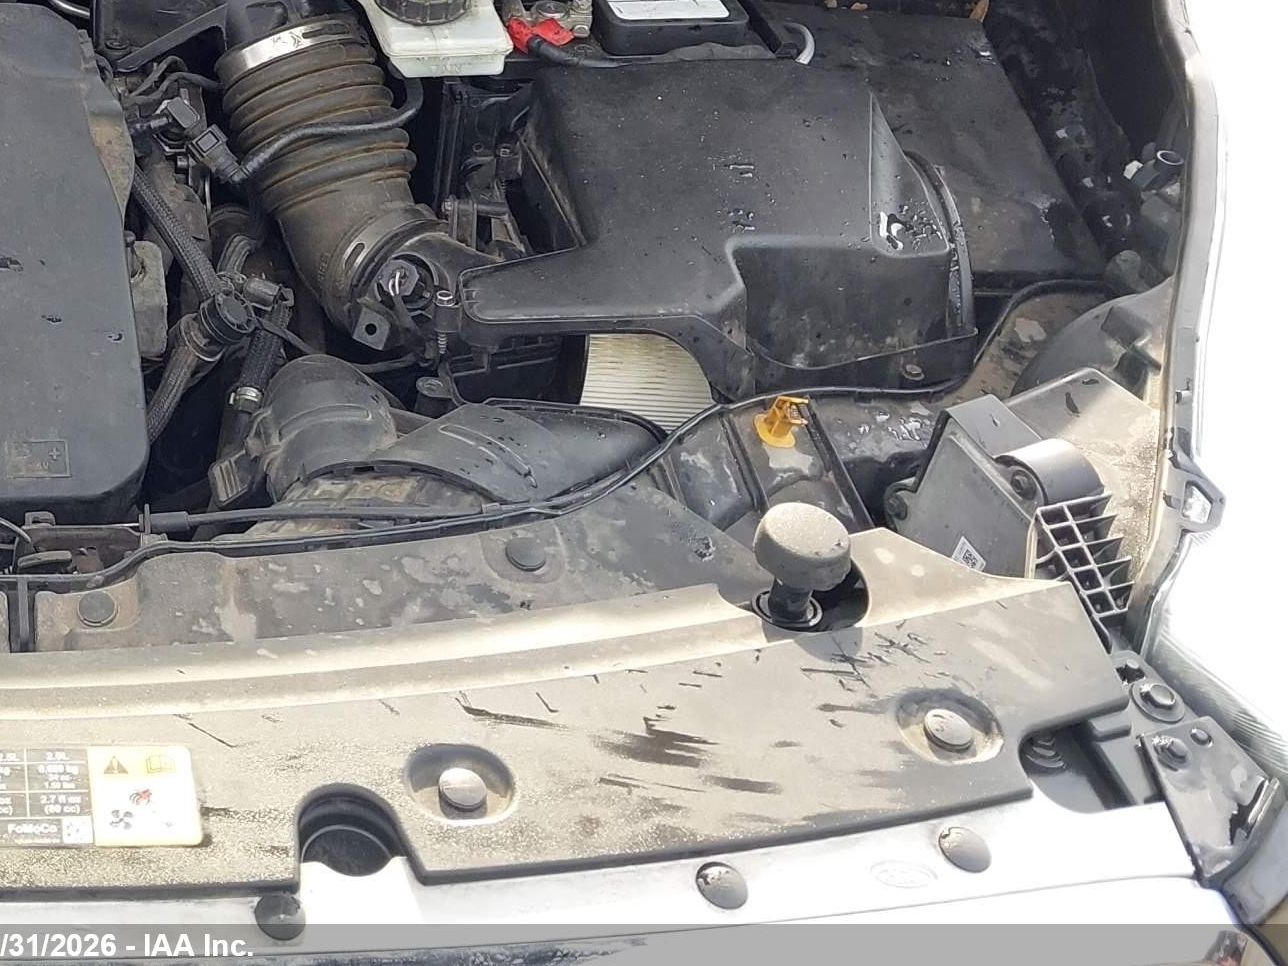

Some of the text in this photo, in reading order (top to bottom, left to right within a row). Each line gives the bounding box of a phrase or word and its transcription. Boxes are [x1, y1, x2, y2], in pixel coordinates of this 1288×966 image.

[40, 795, 56, 804] 2.7
[62, 804, 80, 814] cc)
[7, 823, 57, 835] FoMoCo
